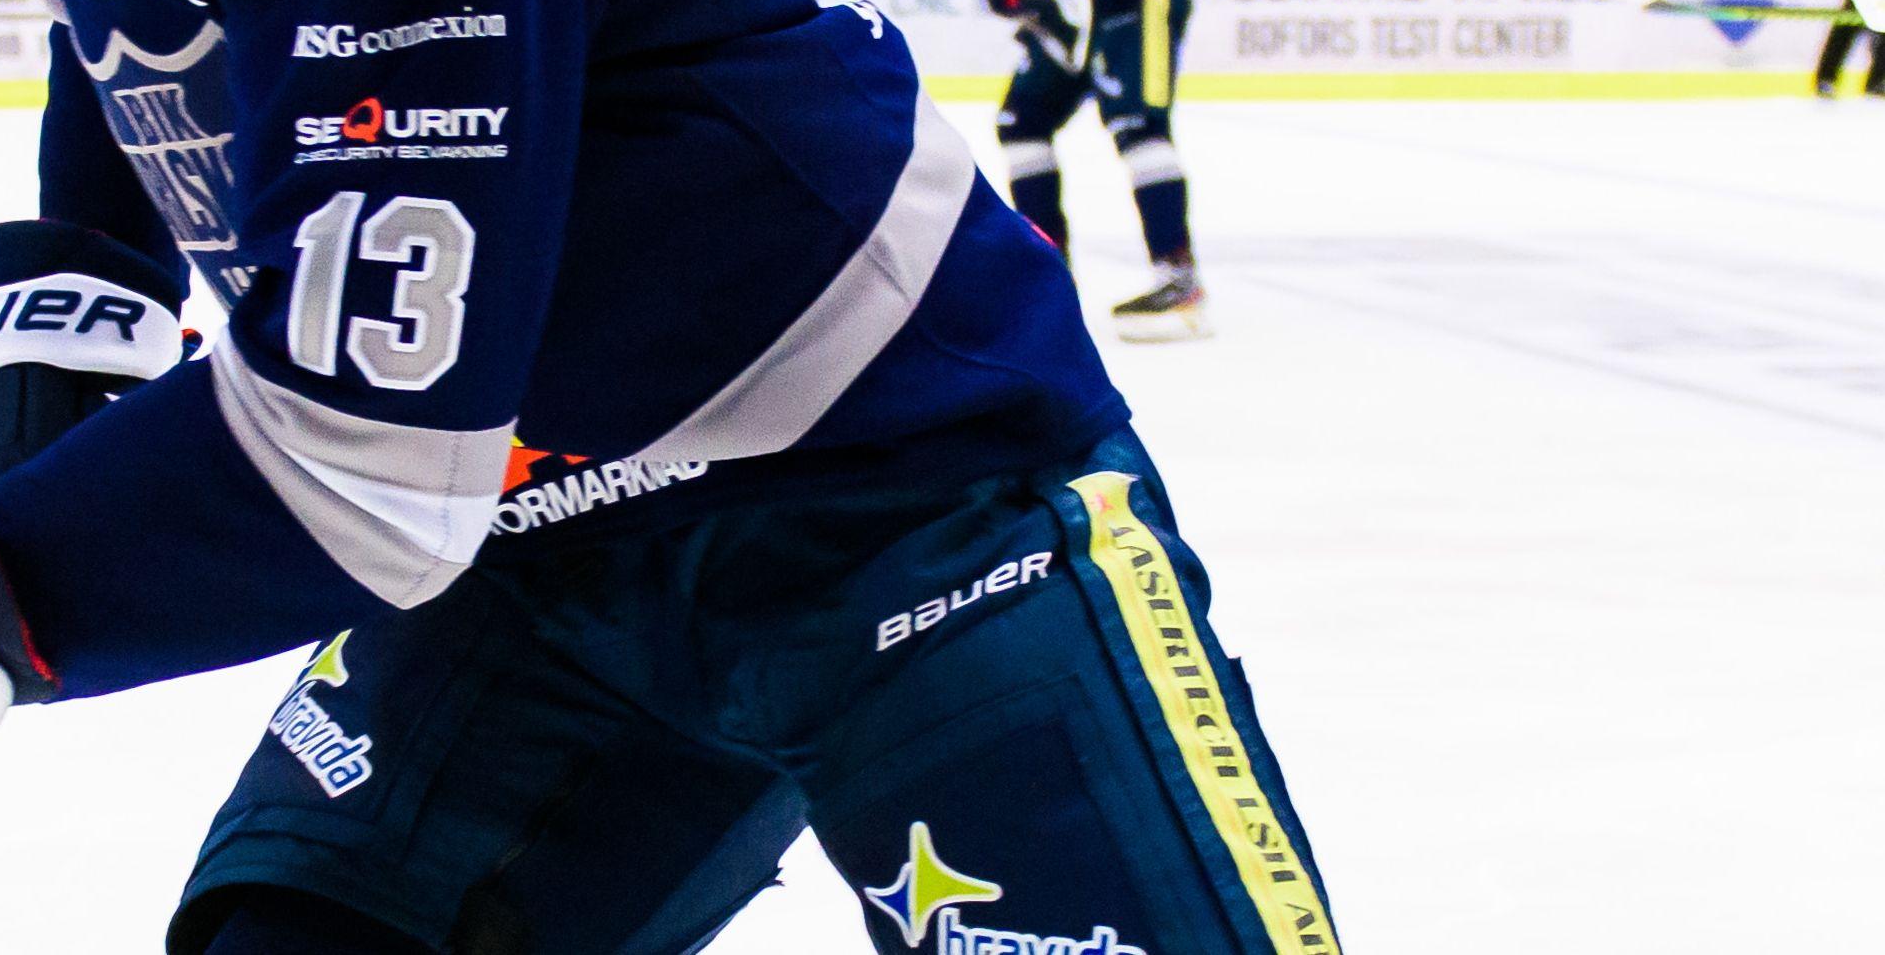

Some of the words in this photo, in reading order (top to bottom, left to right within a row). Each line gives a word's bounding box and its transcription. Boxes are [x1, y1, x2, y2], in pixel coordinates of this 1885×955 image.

[291, 25, 361, 58] ISG
[1236, 17, 1356, 58] BOFORS
[1371, 17, 1439, 57] TEST
[1454, 18, 1571, 56] CENTER
[295, 97, 508, 145] SEQURITY
[287, 191, 476, 391] 13
[876, 551, 1052, 651] BAUER
[269, 683, 373, 798] bravida
